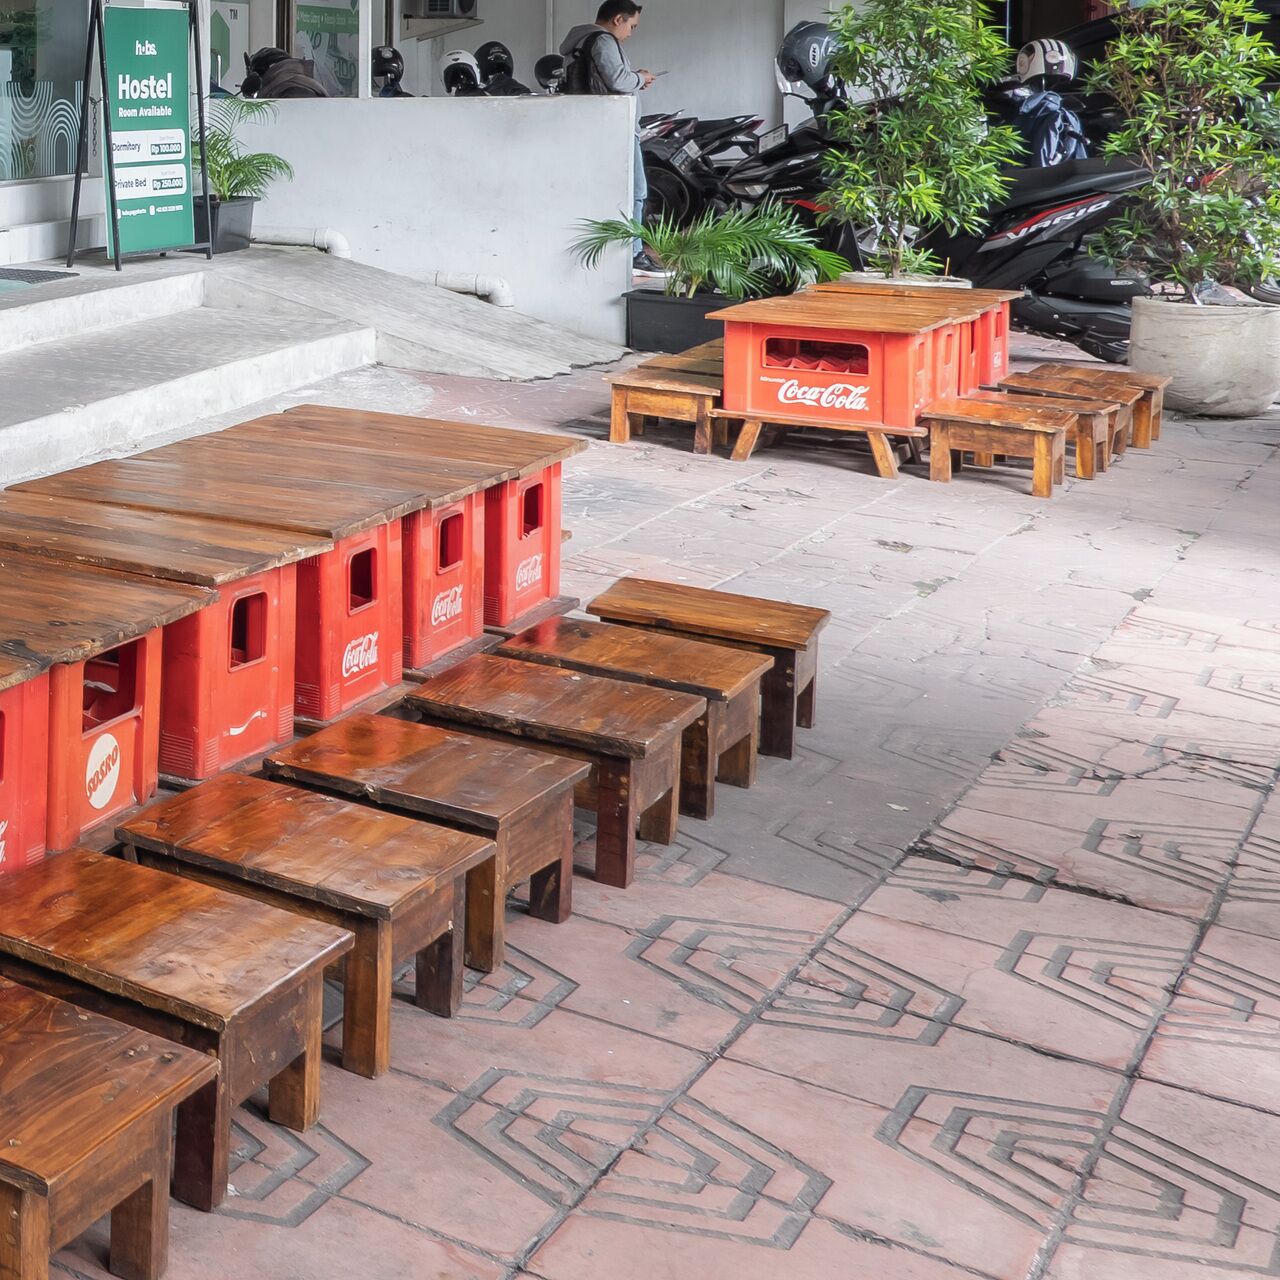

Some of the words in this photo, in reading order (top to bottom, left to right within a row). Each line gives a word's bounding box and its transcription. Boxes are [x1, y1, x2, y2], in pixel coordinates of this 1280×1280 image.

[229, 8, 238, 20] TM
[118, 72, 172, 100] Hostel
[118, 107, 138, 118] Room
[139, 105, 172, 117] Available
[112, 141, 141, 153] Dormitory
[151, 144, 160, 155] Rp
[114, 178, 134, 189] Private
[134, 178, 147, 188] Bed
[153, 180, 161, 190] Rp
[772, 186, 804, 194] HONDA
[1006, 200, 1111, 240] VARIO
[778, 379, 870, 410] Coca-Cola
[87, 744, 119, 799] SOSRO
